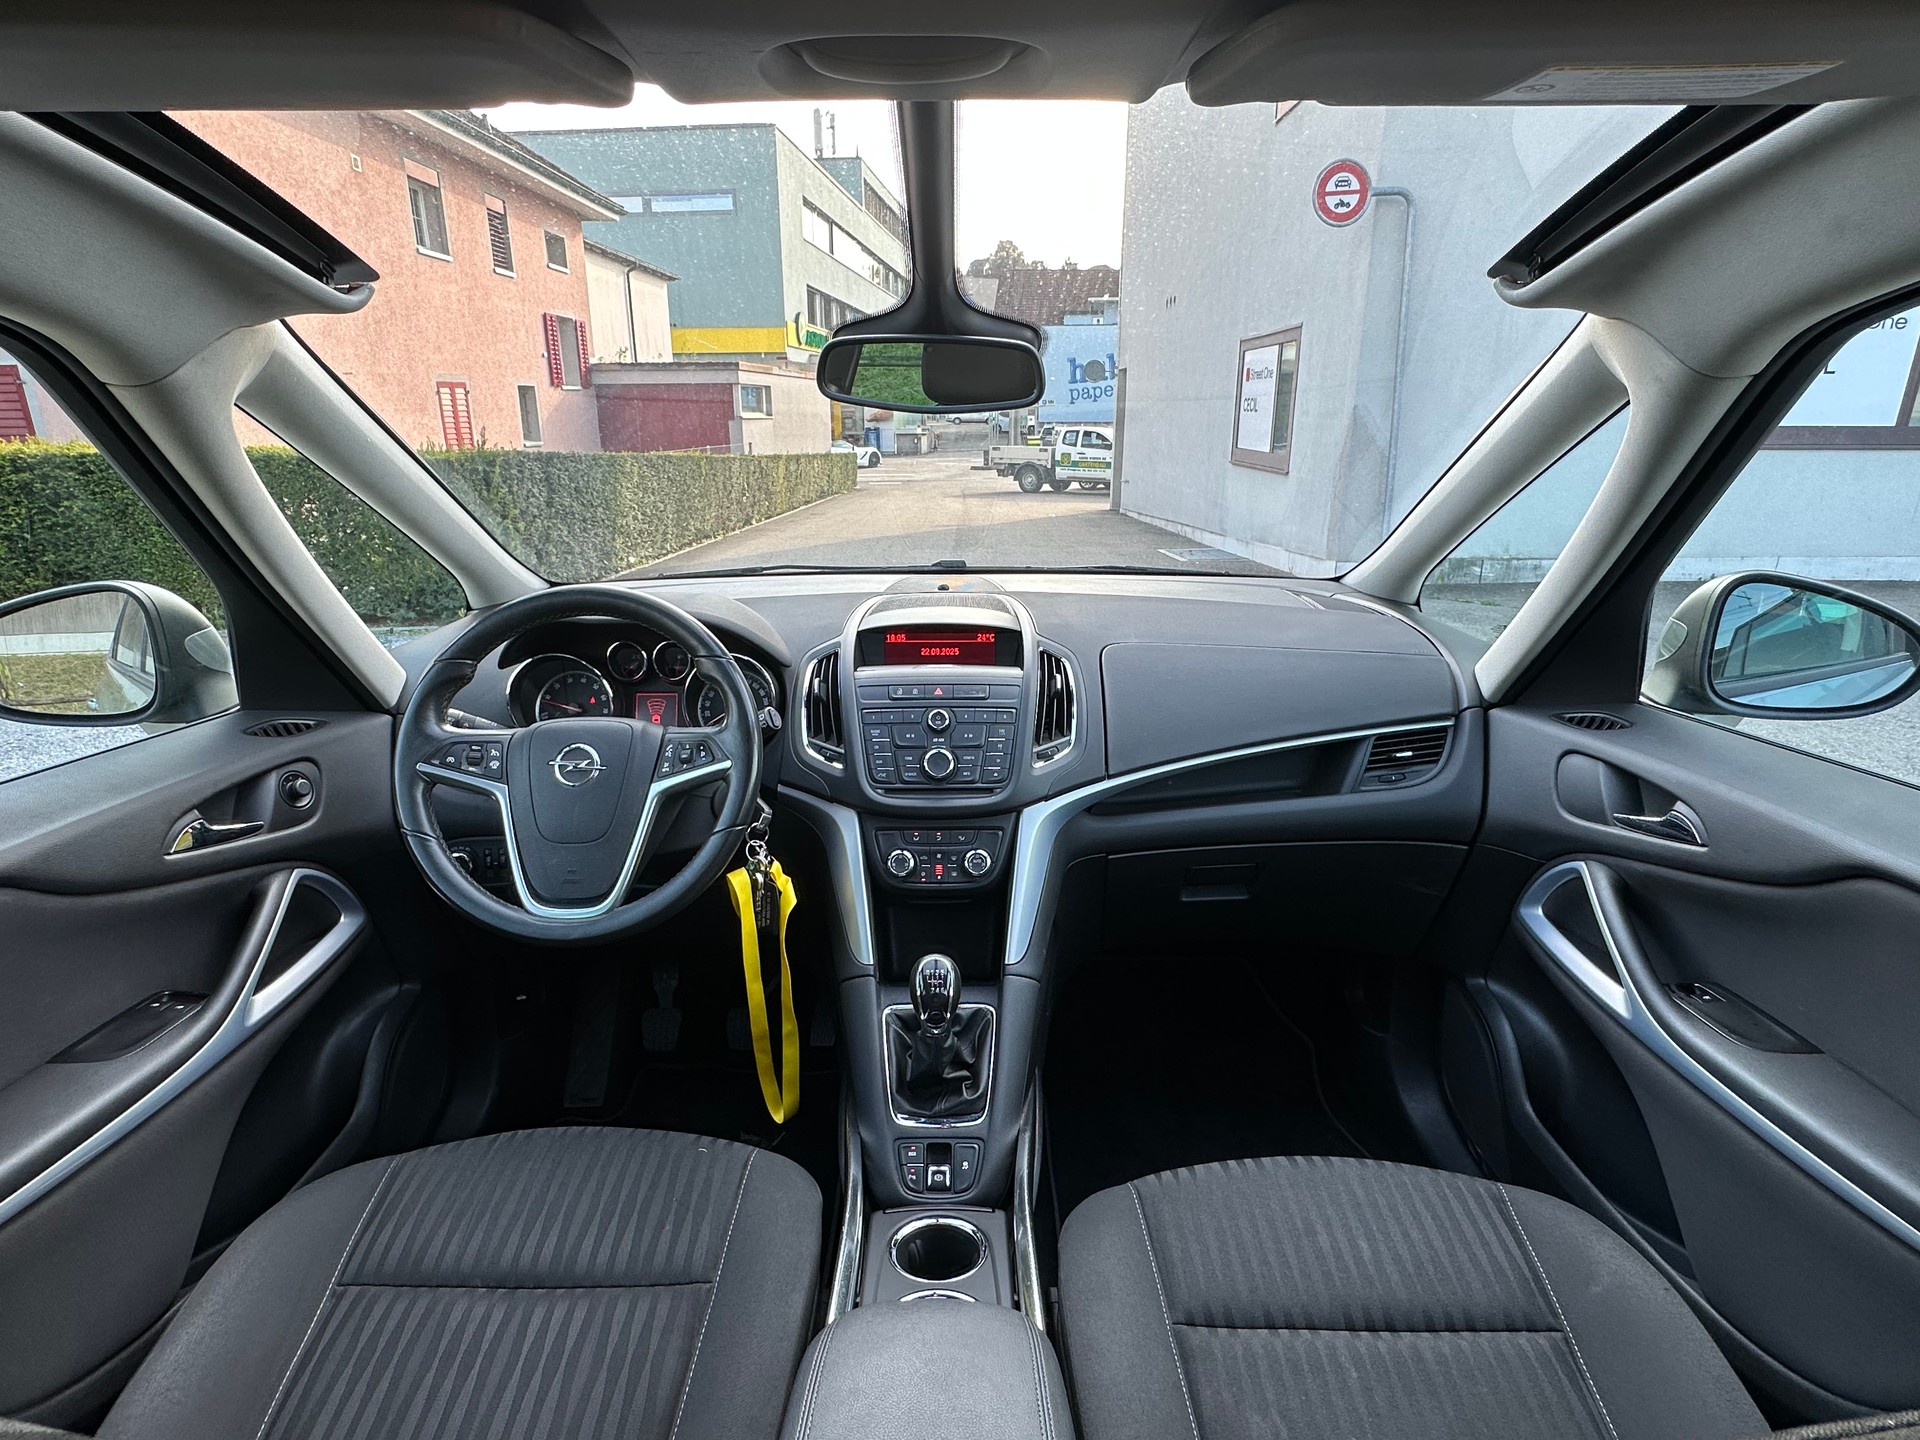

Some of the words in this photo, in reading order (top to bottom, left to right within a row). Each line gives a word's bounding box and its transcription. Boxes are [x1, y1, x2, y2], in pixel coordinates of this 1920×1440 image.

[1869, 316, 1908, 330] ne
[1250, 368, 1264, 381] Street
[1264, 366, 1275, 380] One
[1243, 397, 1258, 412] CECIL
